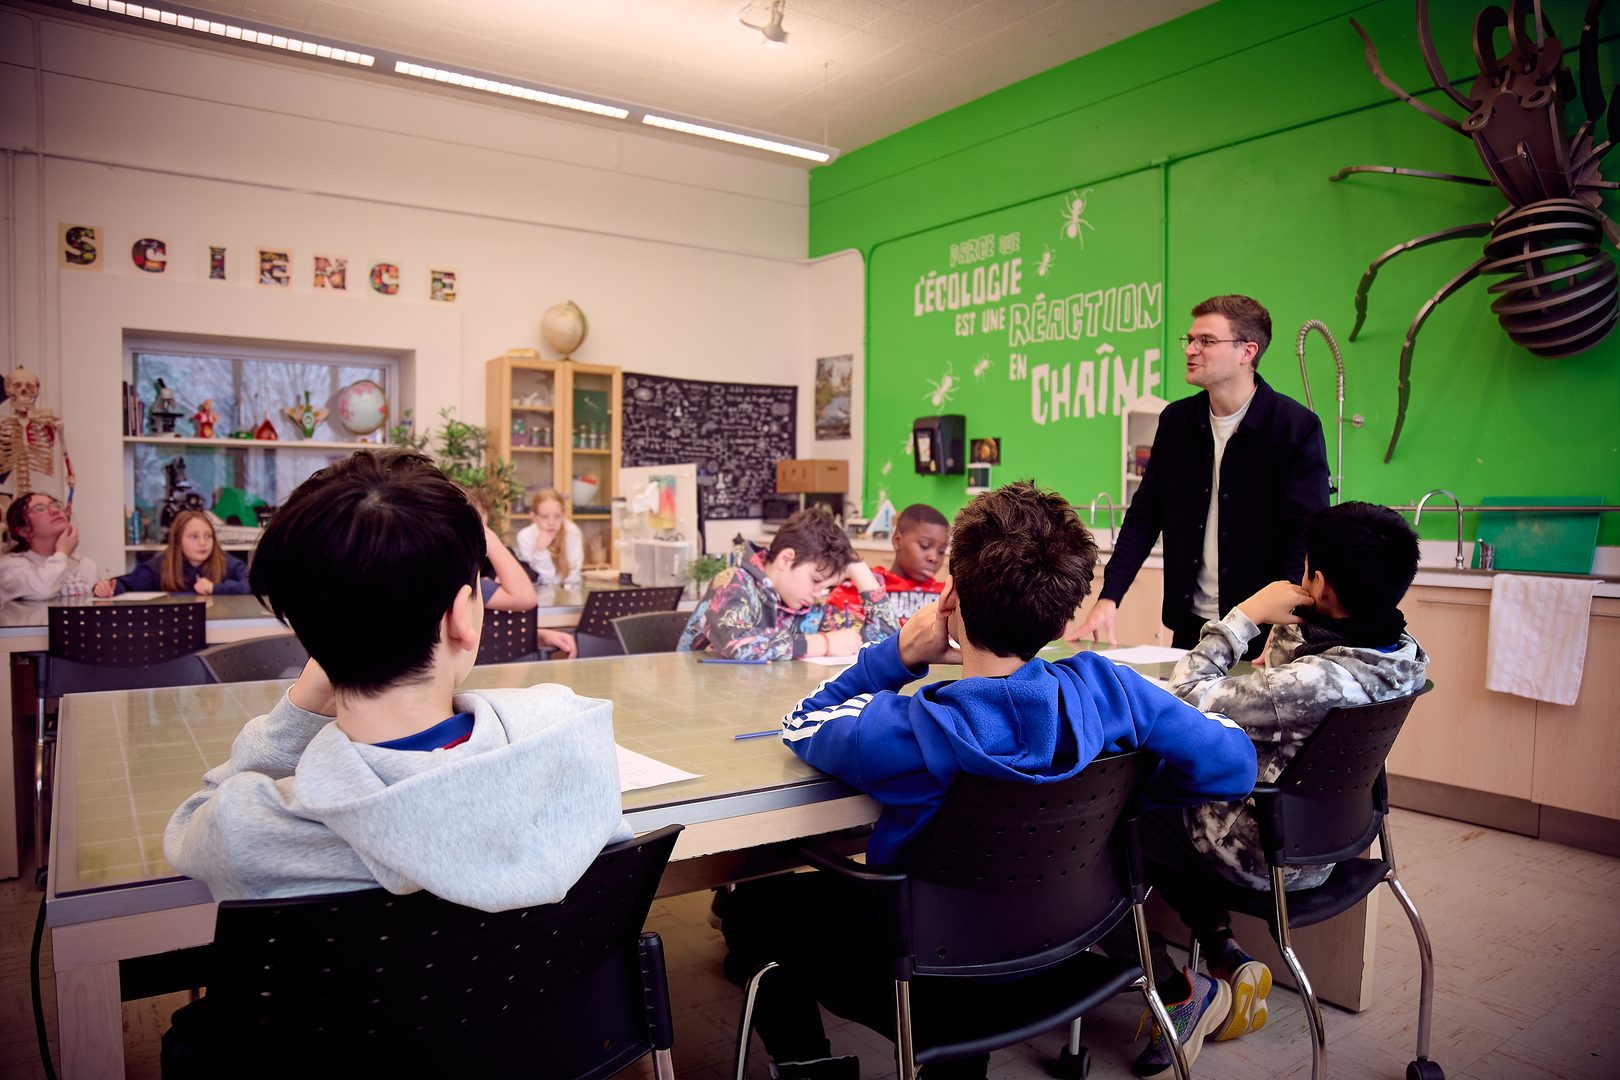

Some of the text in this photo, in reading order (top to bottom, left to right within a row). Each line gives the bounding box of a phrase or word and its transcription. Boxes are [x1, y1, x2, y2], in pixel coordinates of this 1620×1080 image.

[65, 226, 457, 302] SCIENCE
[950, 232, 1020, 267] PARCE QUE
[914, 258, 1022, 316] L'ÉCOLOGIE
[955, 282, 1162, 347] EST UNE RÉACTION
[1009, 343, 1161, 425] EN CHAÎNE
